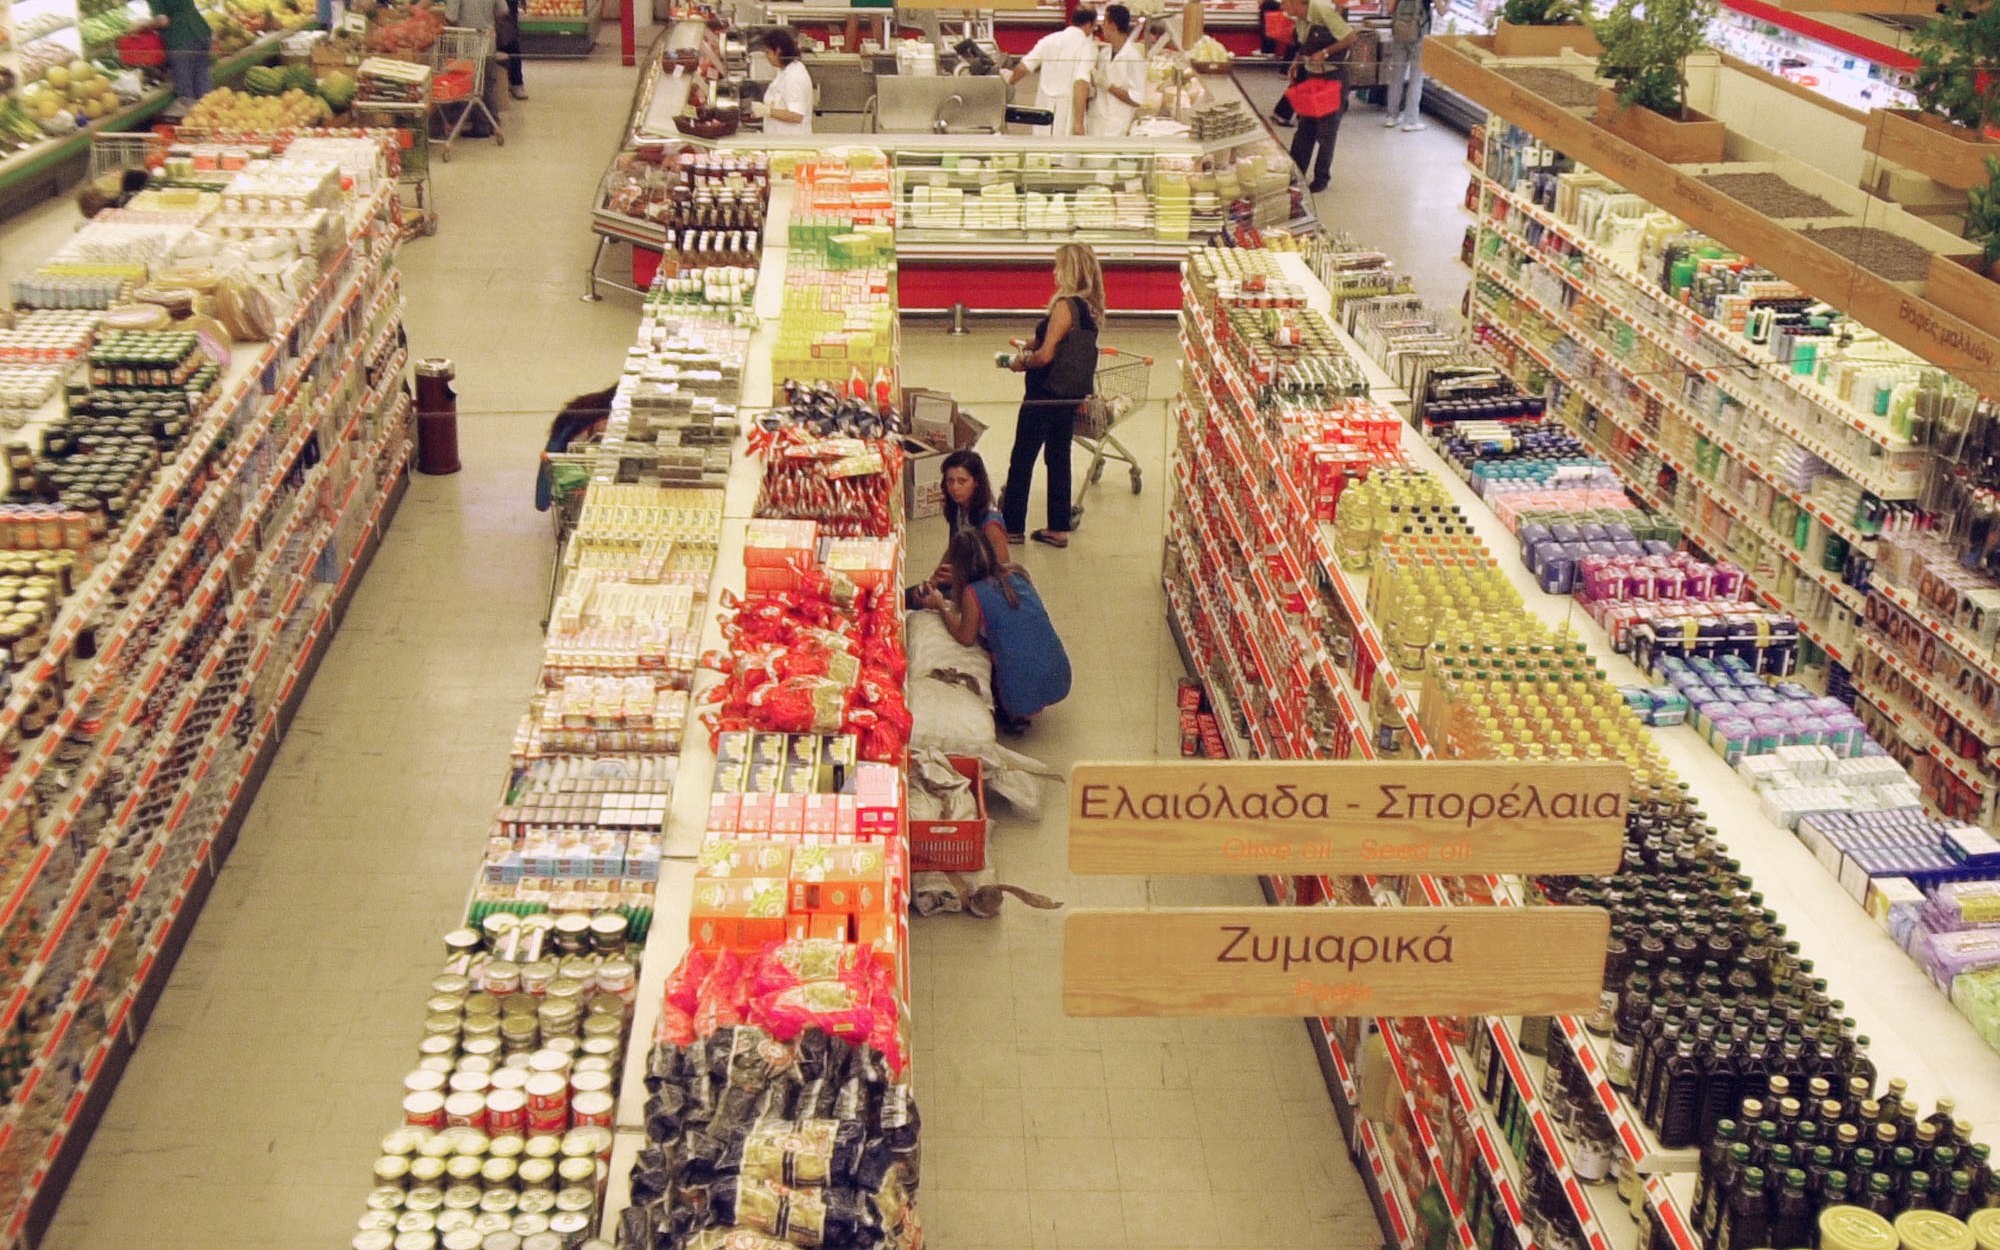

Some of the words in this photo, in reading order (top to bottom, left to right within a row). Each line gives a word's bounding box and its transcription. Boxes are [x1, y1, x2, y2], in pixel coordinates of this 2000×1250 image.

[1081, 783, 1330, 820] Ελαιόλαδα
[1376, 783, 1621, 828] Σπορέλαια
[1222, 837, 1293, 860] Olive
[1301, 838, 1333, 860] oil
[1359, 838, 1432, 861] Seed
[1440, 838, 1472, 861] oil
[1217, 925, 1454, 972] Ζυμαρικά
